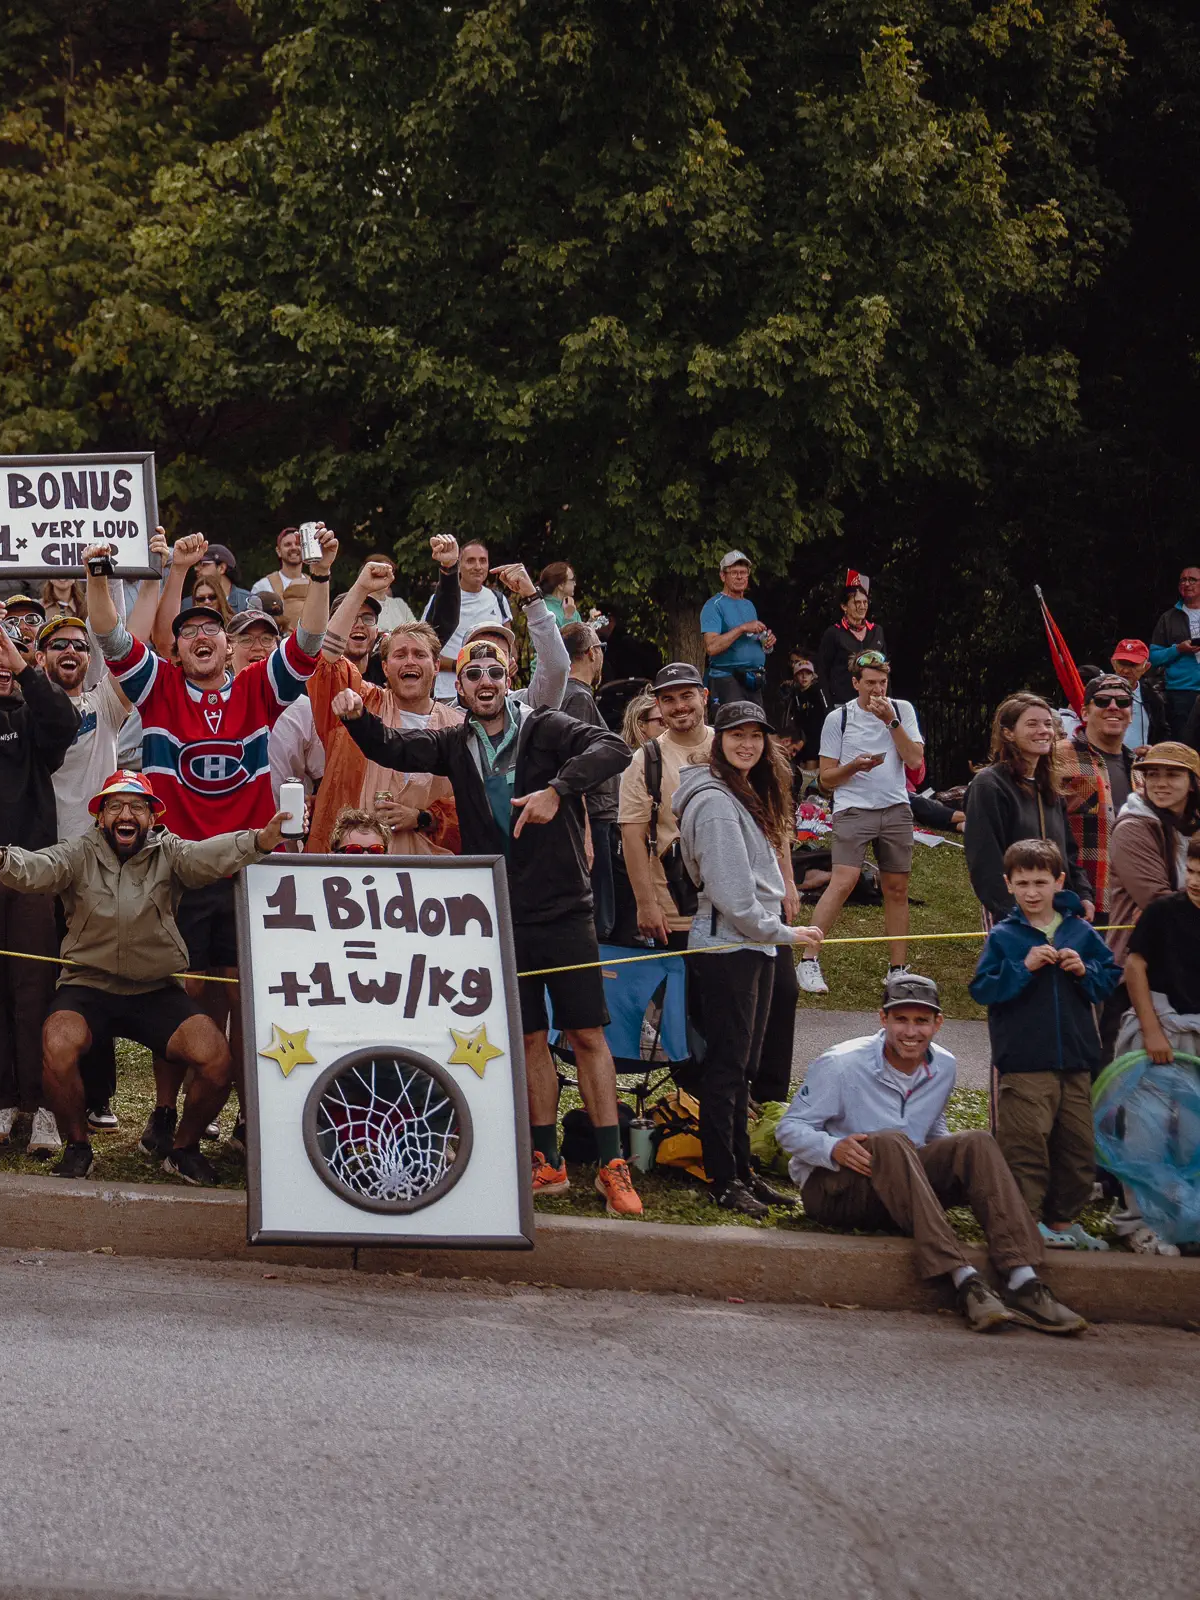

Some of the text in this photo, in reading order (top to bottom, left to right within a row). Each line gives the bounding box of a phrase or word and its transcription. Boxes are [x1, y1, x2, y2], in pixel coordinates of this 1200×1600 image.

[7, 469, 133, 512] BONUS
[31, 519, 86, 539] VERY
[92, 519, 139, 539] LOUD
[41, 542, 119, 566] CHER
[729, 704, 765, 721] ciele
[262, 871, 494, 938] 1 Bidon
[343, 940, 378, 960] =
